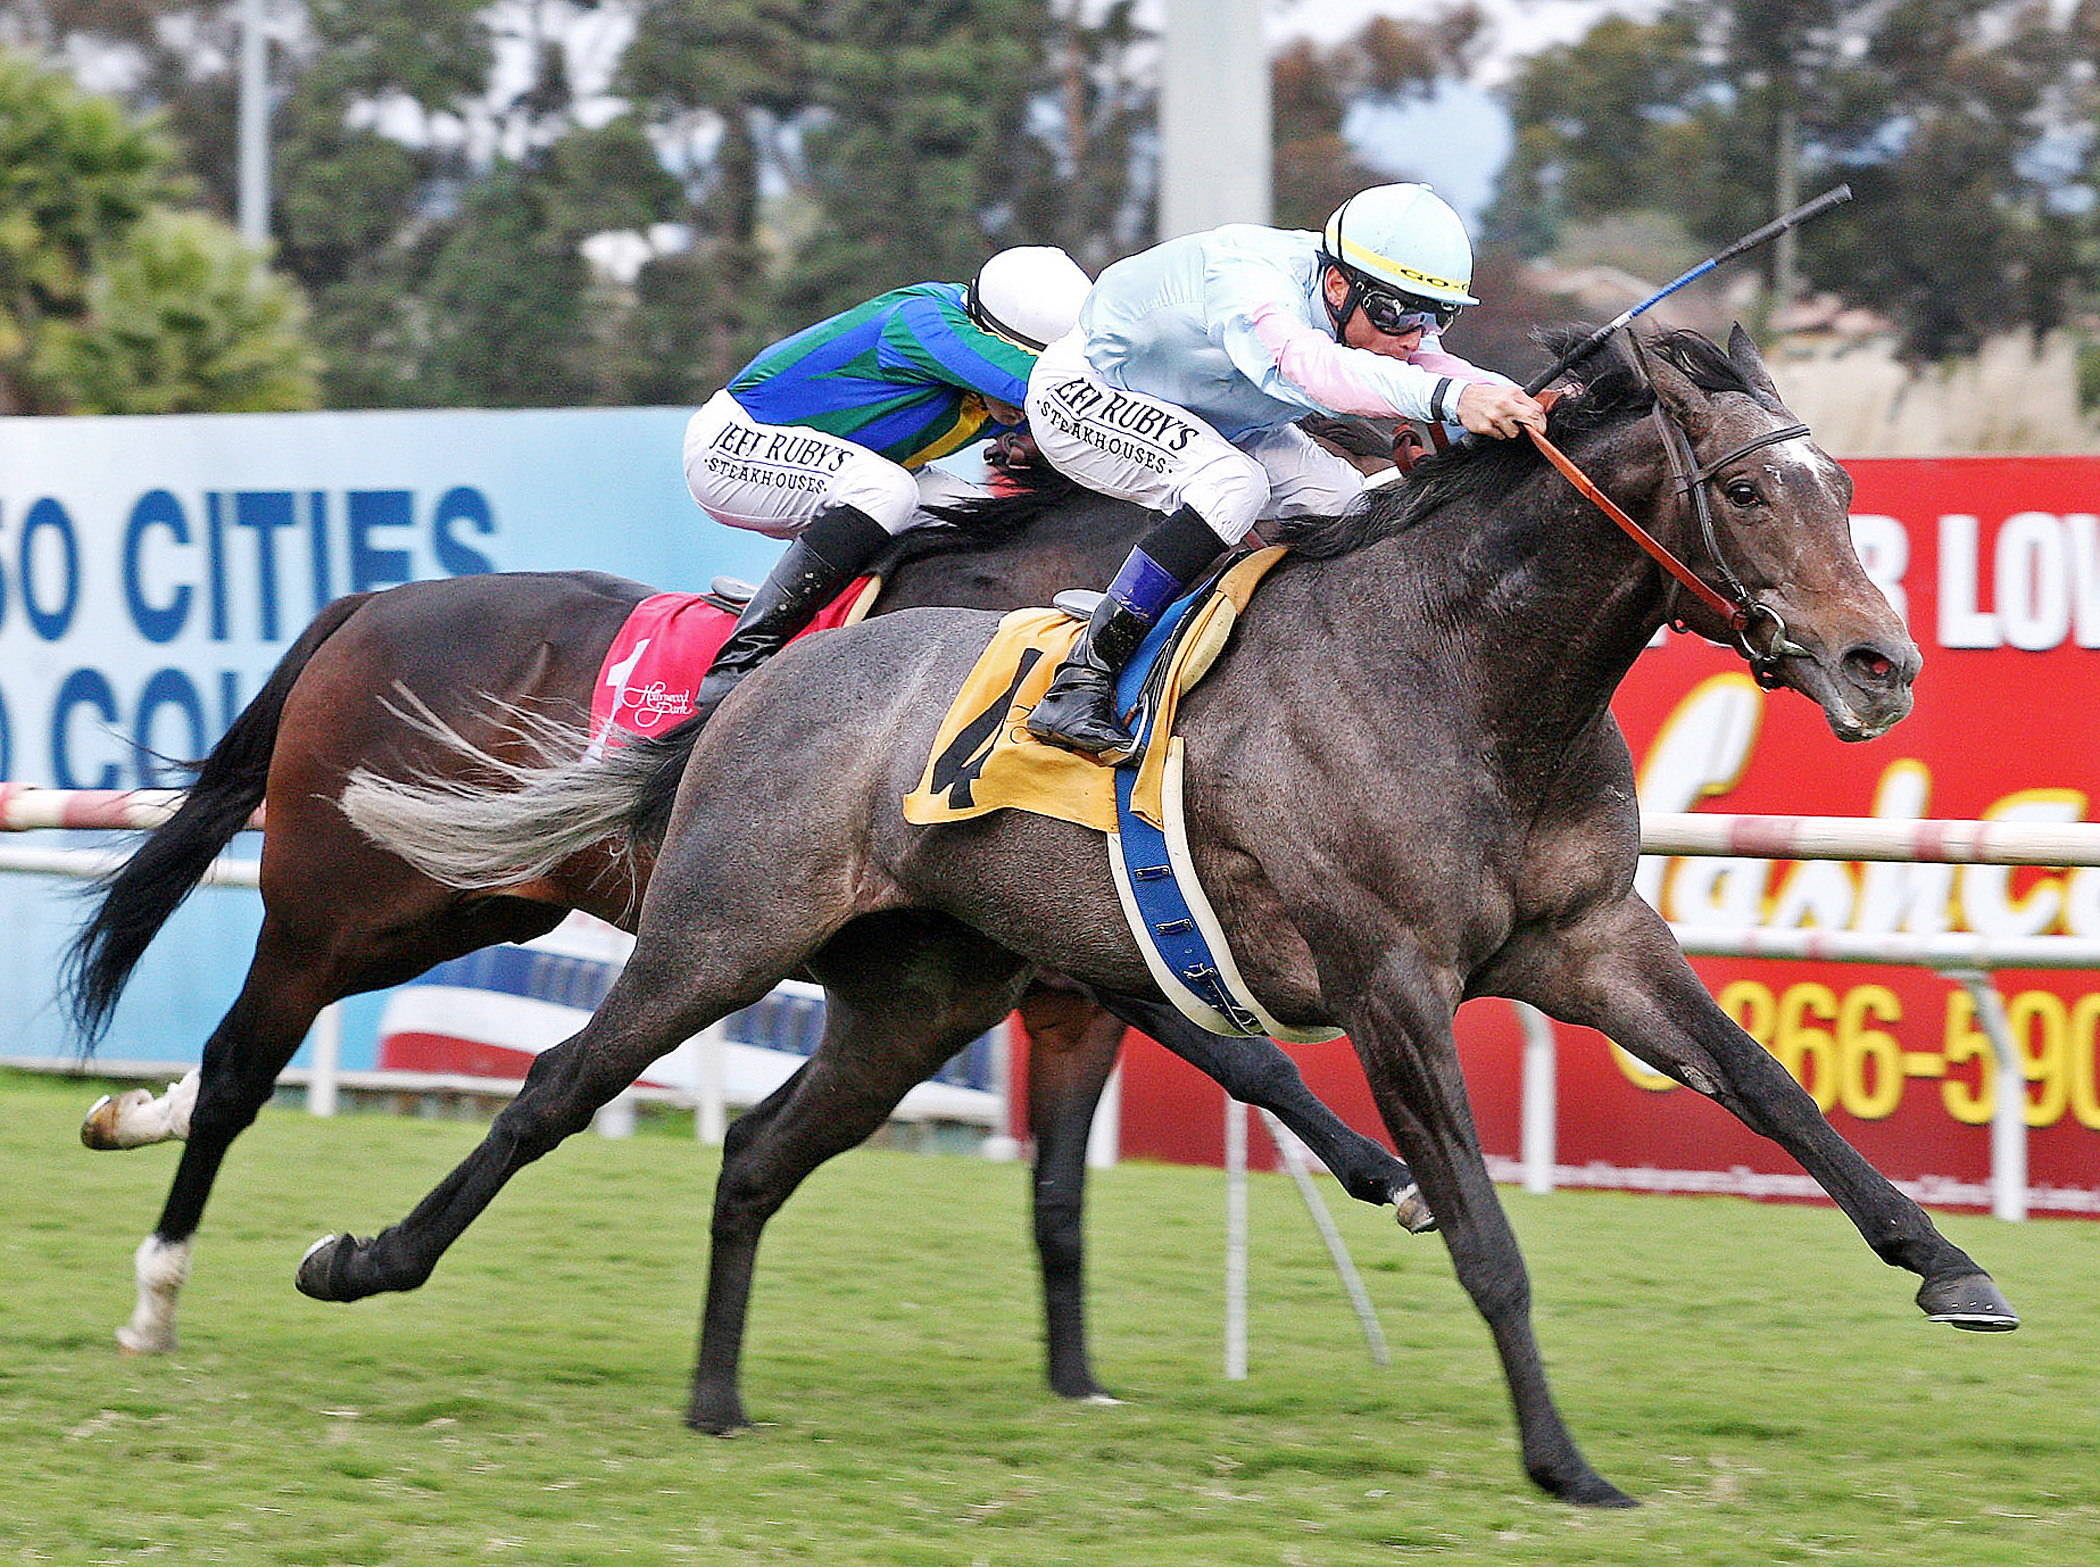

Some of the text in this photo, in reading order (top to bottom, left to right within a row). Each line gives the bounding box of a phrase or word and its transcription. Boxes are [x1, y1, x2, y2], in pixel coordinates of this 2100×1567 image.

[765, 433, 855, 472] RUBY'S
[1040, 401, 1167, 474] STEAKHOUSES
[1098, 392, 1200, 451] RUBY'S
[708, 457, 823, 495] STEAKHOUSES
[121, 485, 499, 642] CITIES
[1936, 511, 2100, 652] LO
[581, 639, 651, 766] 1
[930, 647, 1045, 809] 4
